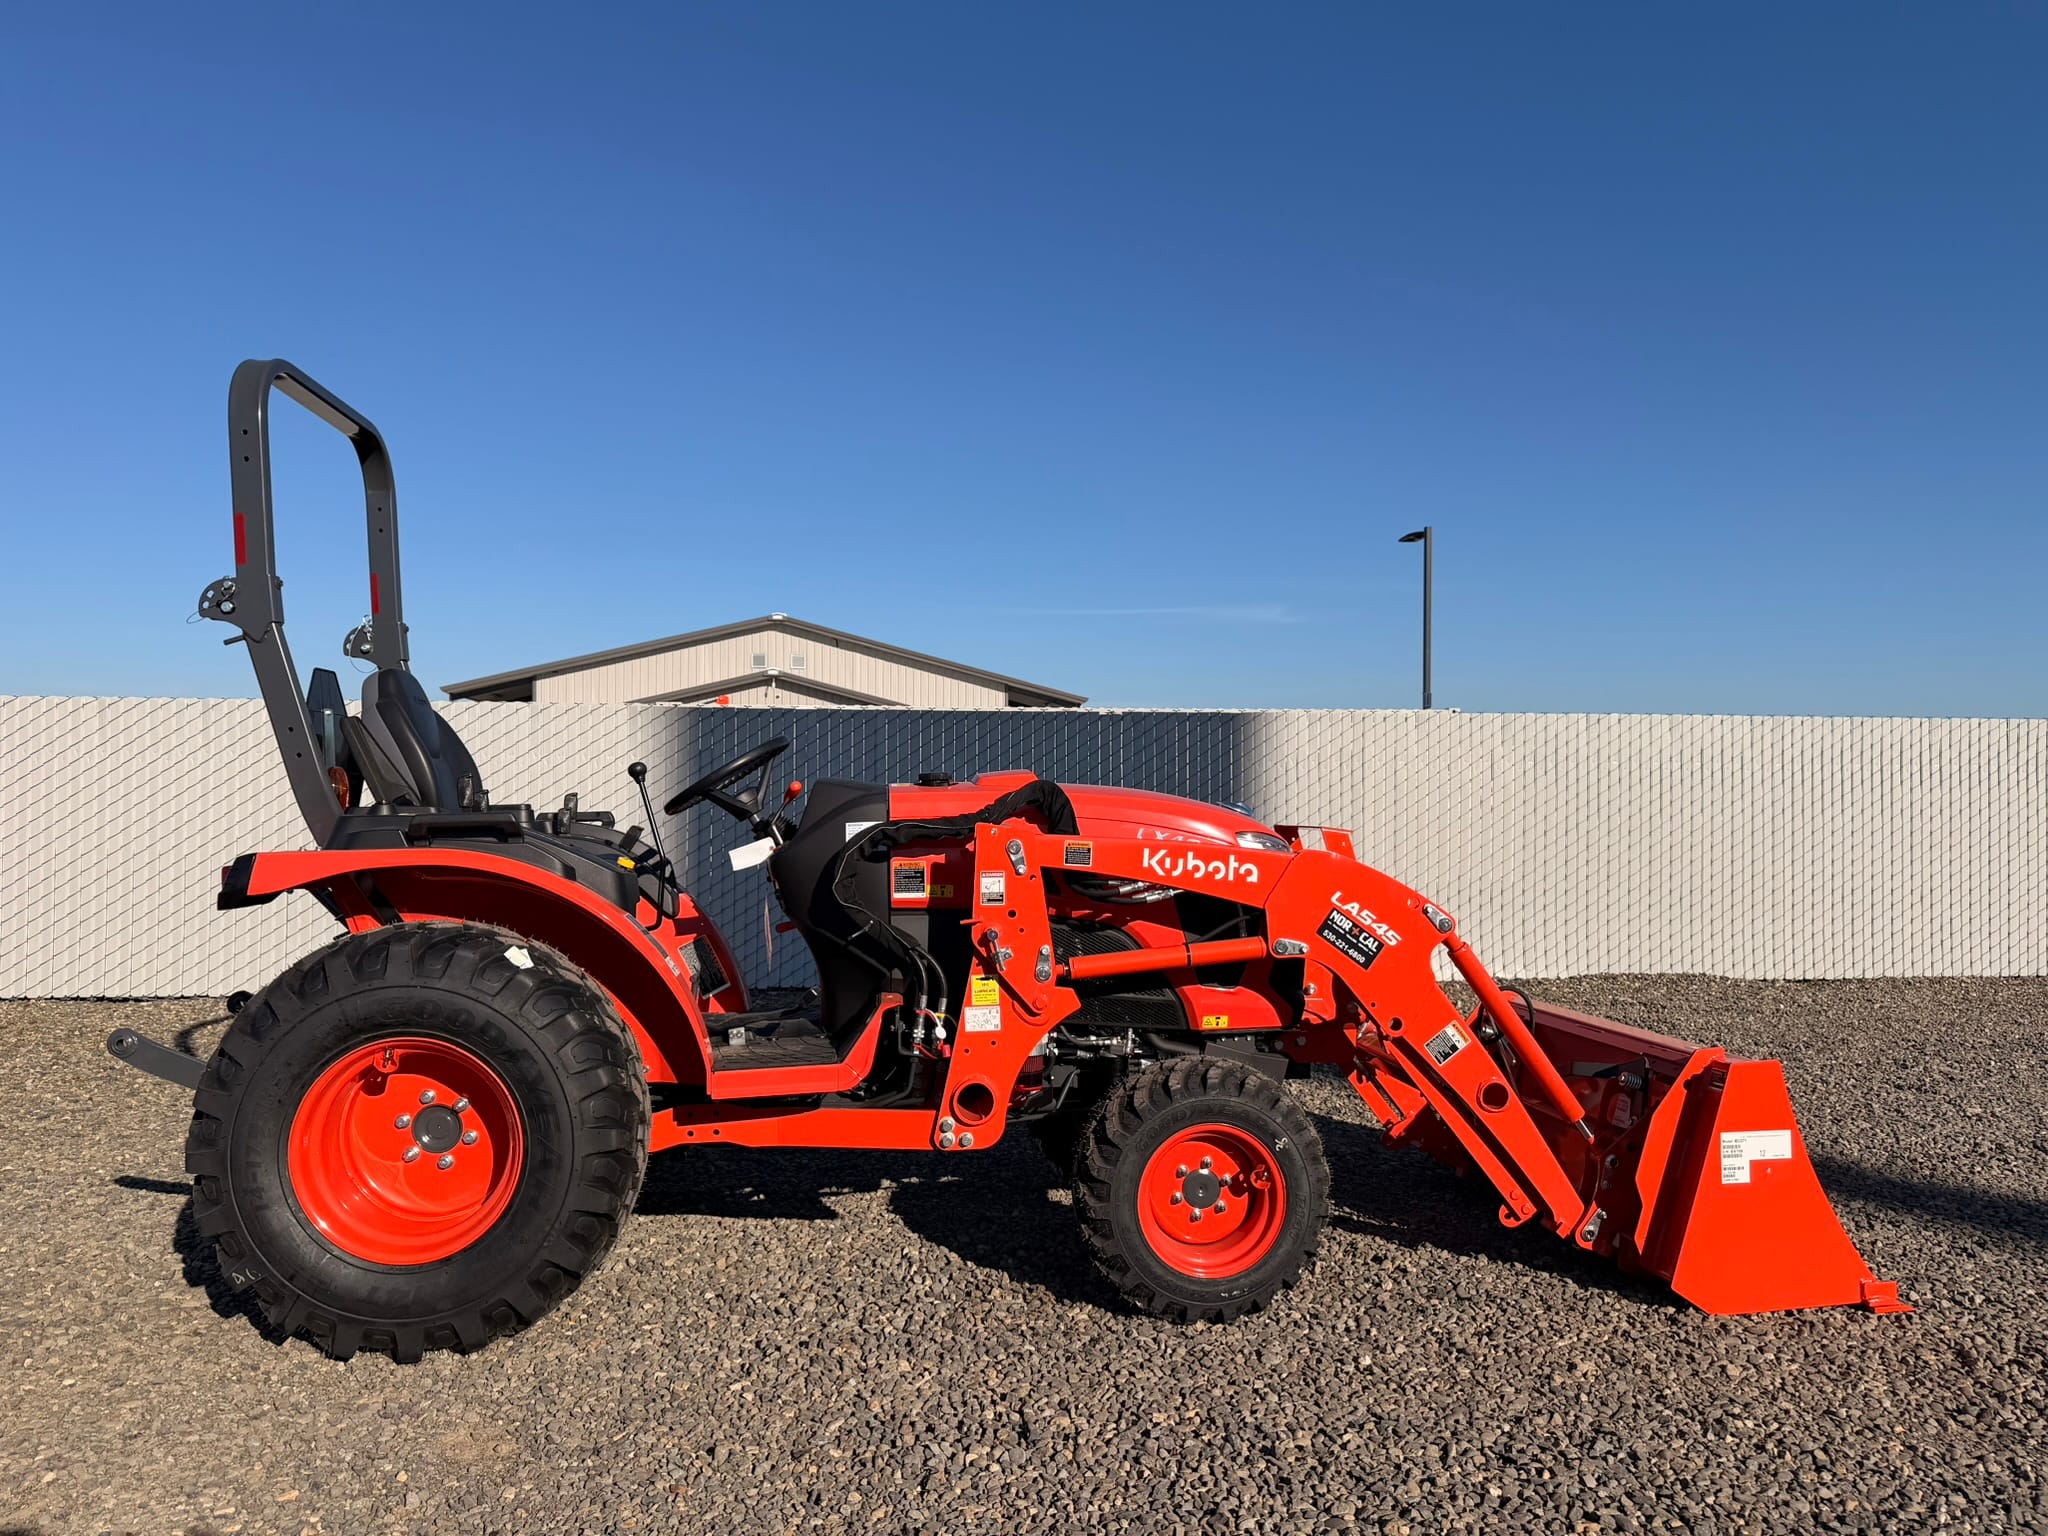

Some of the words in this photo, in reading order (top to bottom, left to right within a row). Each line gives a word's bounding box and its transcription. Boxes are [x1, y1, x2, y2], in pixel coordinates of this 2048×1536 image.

[1142, 847, 1259, 883] Kubota
[1329, 909, 1353, 932] NOR
[1358, 931, 1379, 953] CAL
[1330, 891, 1402, 946] LA545
[1322, 929, 1366, 964] 530-221-6800
